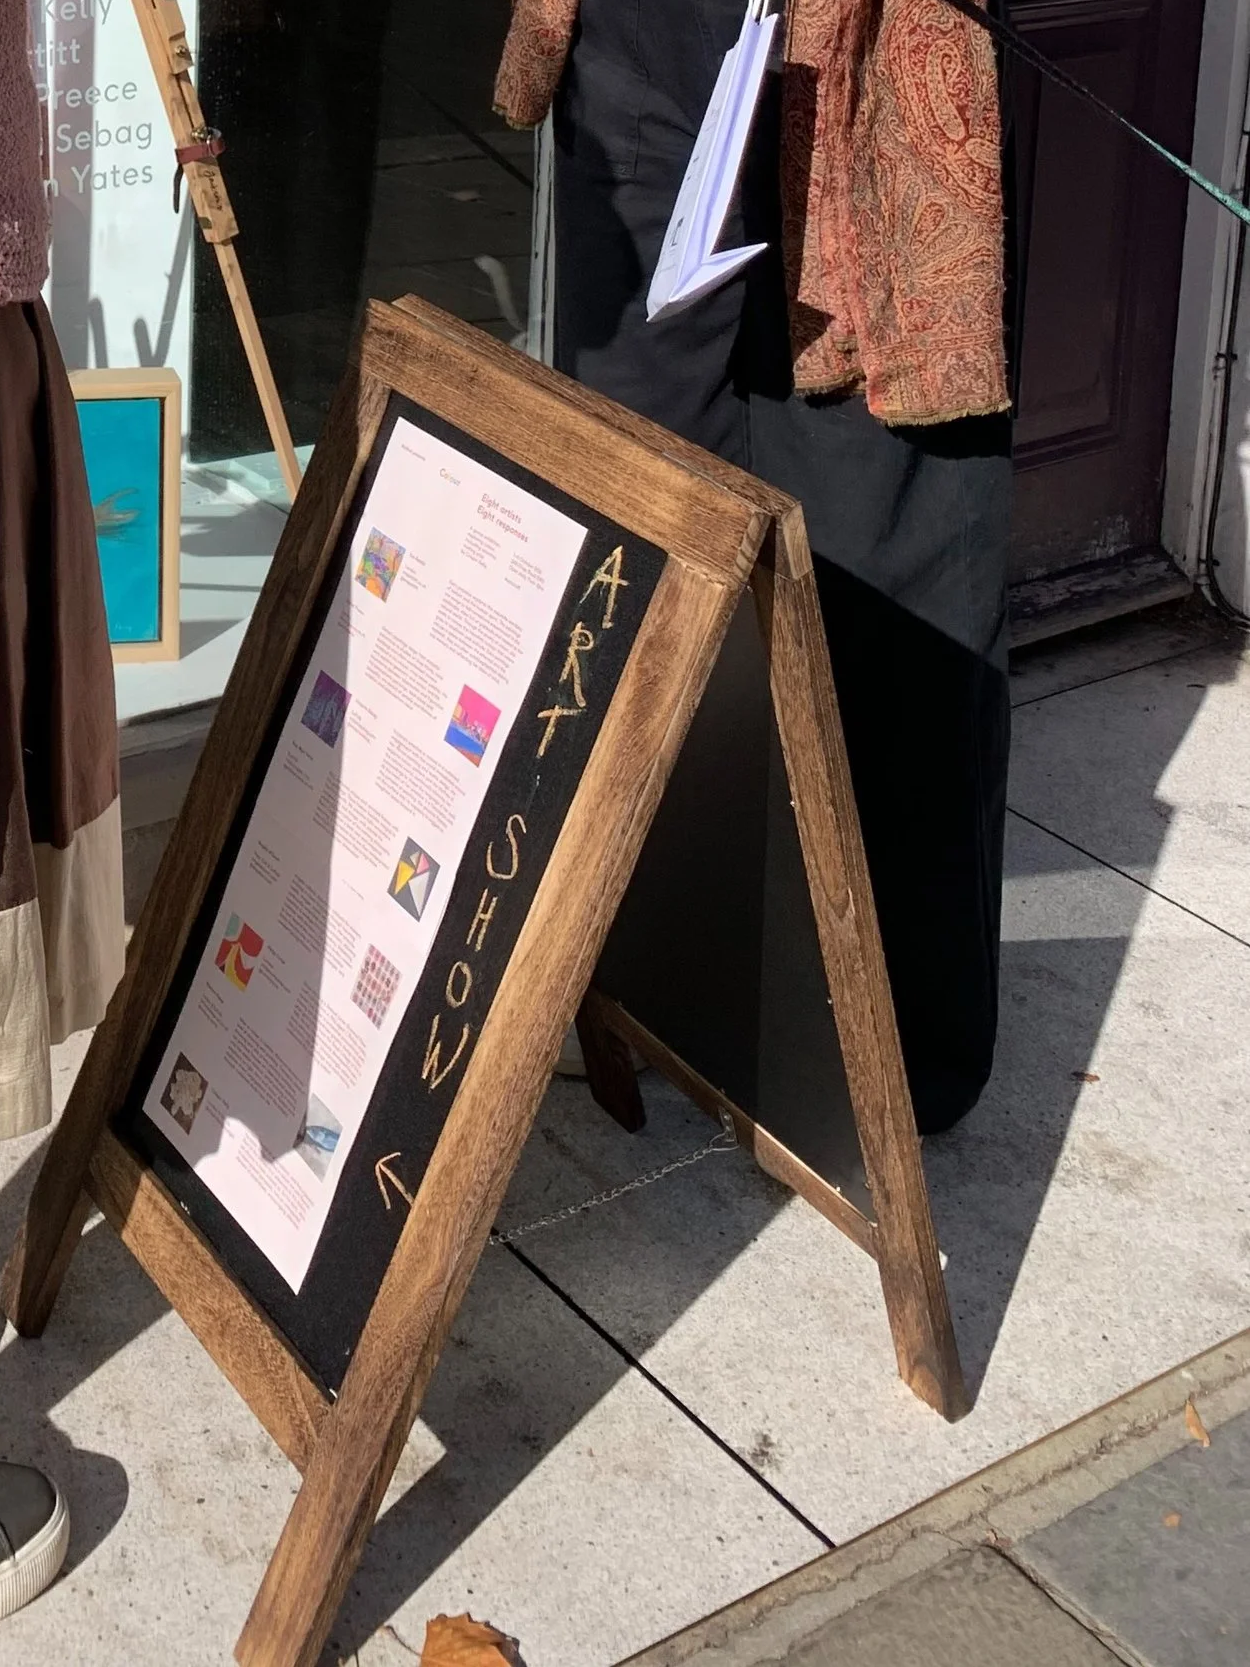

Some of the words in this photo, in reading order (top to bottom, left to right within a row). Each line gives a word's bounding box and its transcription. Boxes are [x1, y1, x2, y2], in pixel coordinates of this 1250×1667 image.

[34, 37, 81, 69] titt
[36, 81, 138, 111] Preece
[55, 119, 153, 153] Sebag
[70, 163, 154, 194] Yates
[477, 504, 495, 521] Eight
[496, 518, 529, 544] responses
[481, 493, 500, 511] Eight
[500, 506, 522, 525] artists
[536, 544, 630, 760] ART
[420, 813, 527, 1094] SHOW
